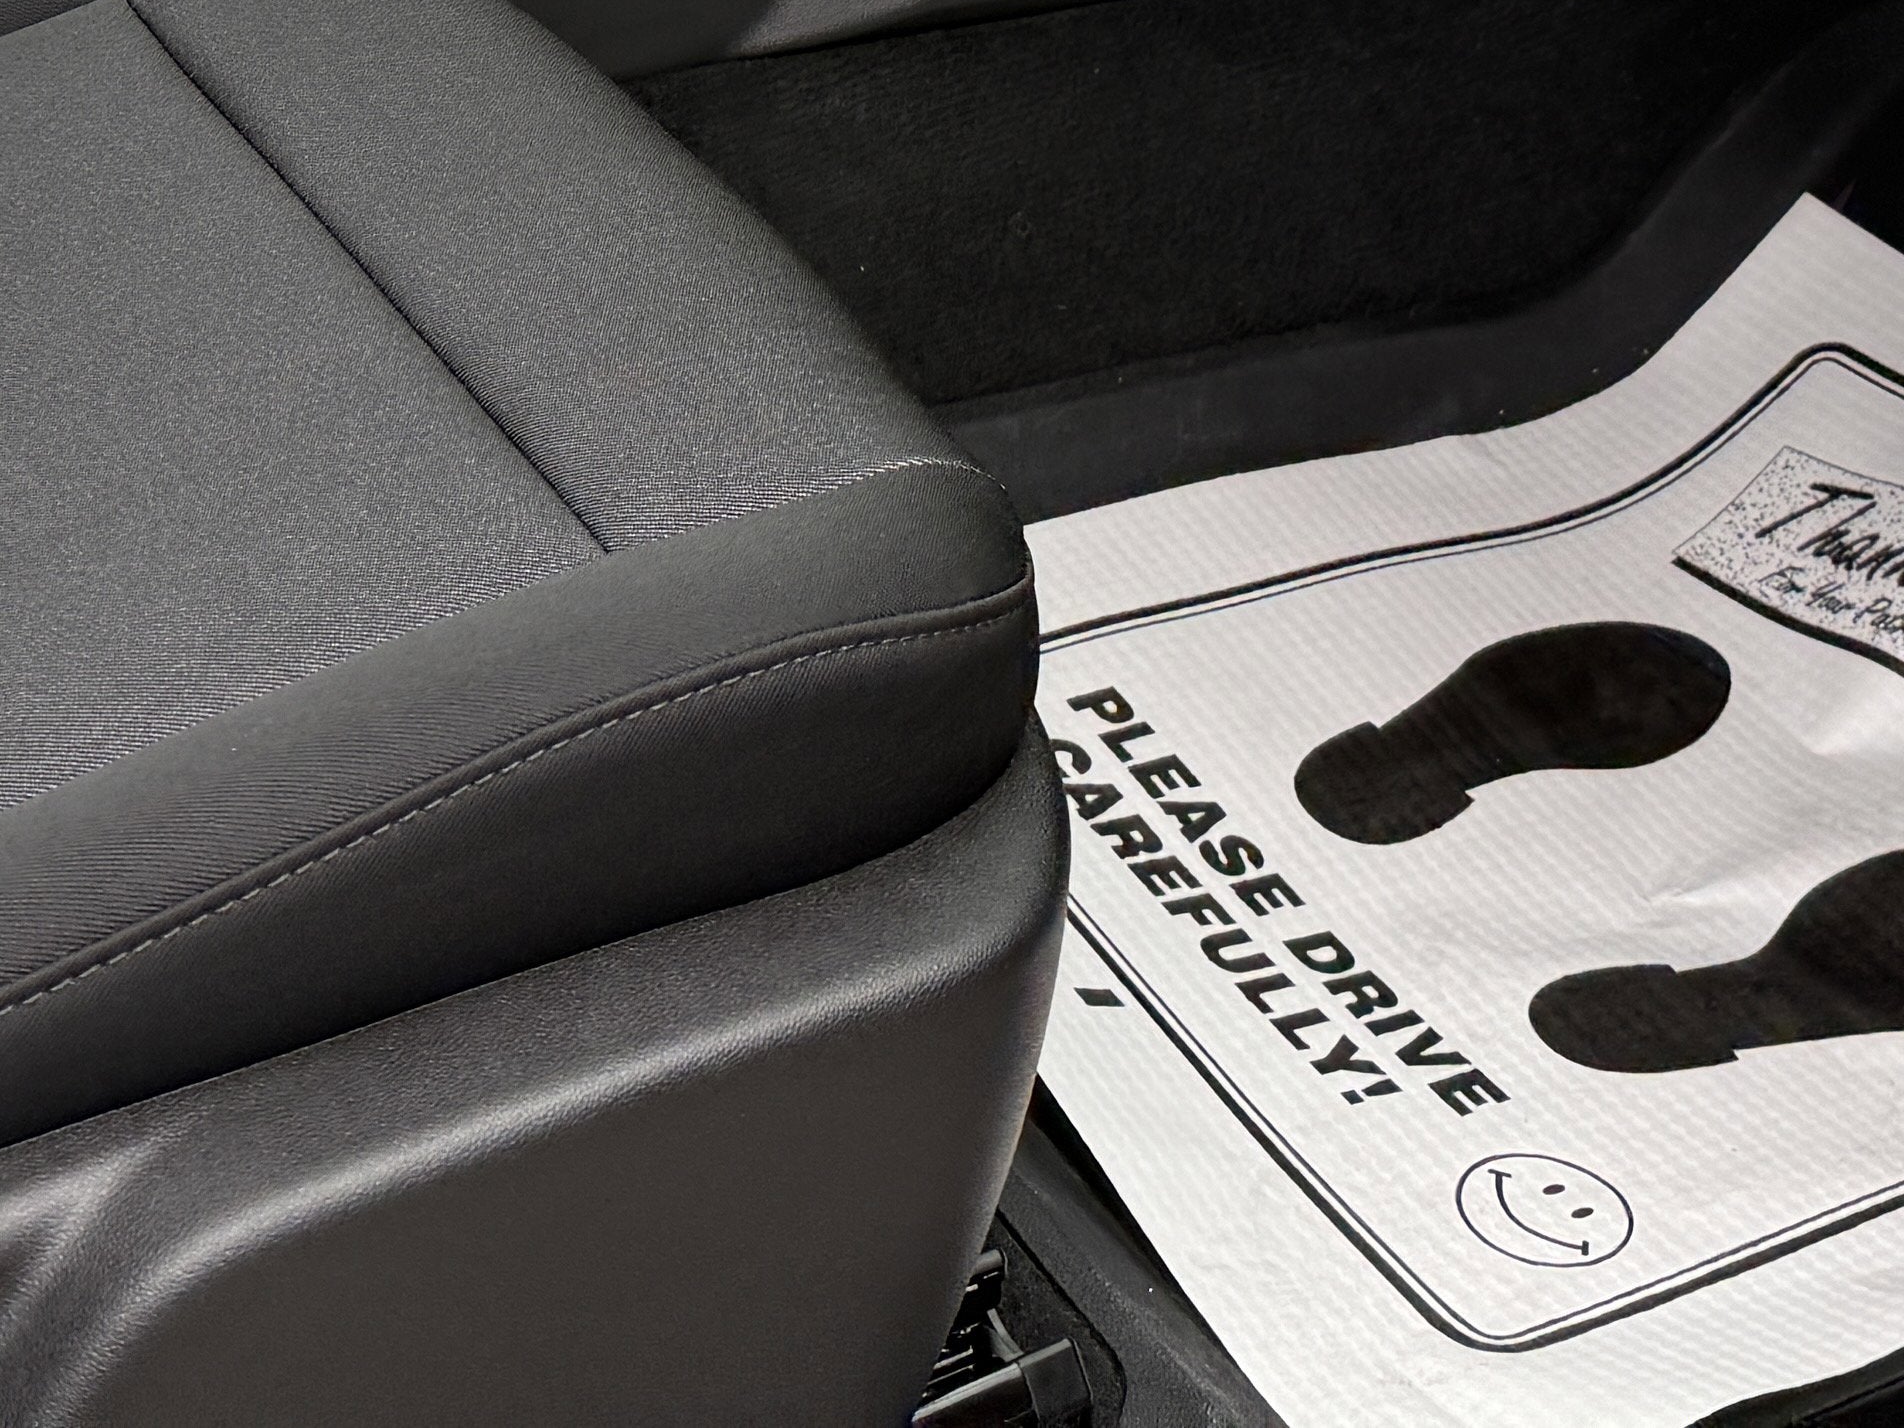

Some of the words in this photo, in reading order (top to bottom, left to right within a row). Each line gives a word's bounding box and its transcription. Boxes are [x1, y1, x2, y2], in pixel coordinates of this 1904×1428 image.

[1756, 564, 1805, 596] For
[1805, 576, 1857, 618] Your
[1049, 737, 1405, 1107] CAREFULLY!
[1066, 684, 1308, 918] PLEASE
[1281, 929, 1512, 1118] DRIVE
